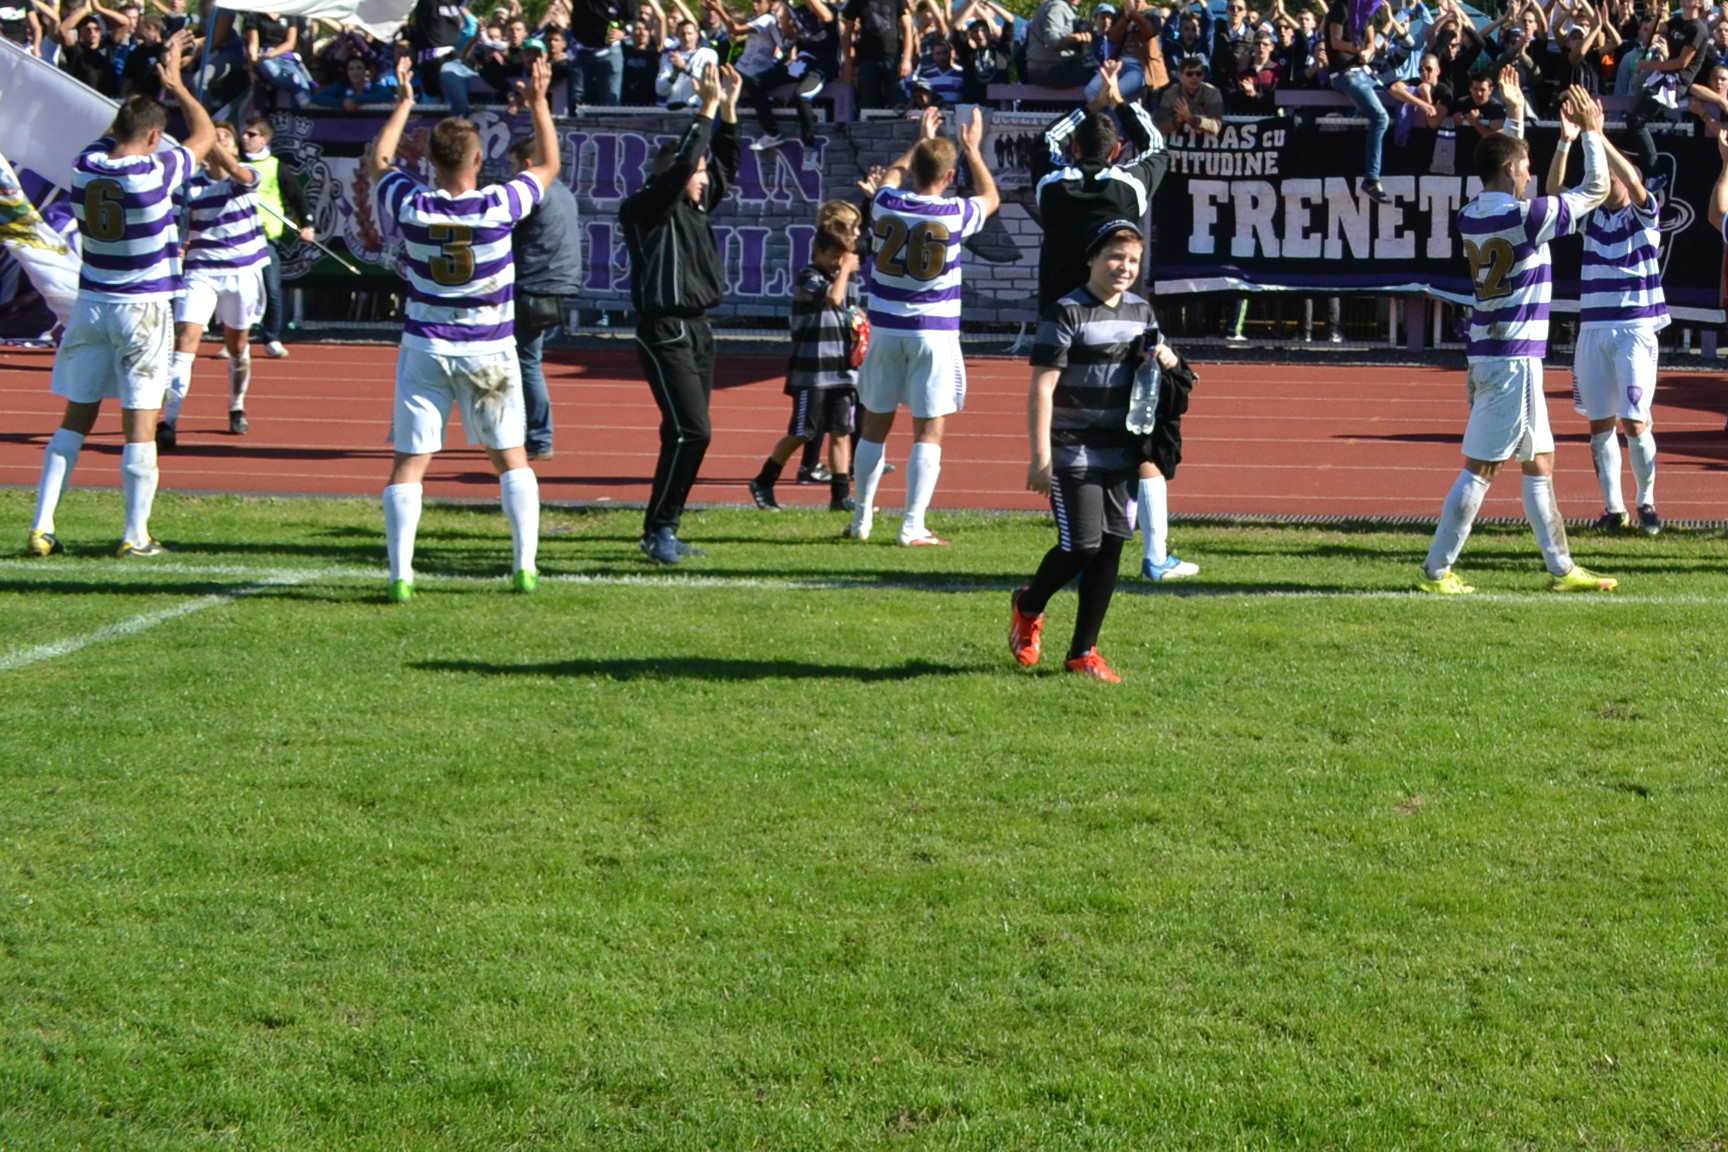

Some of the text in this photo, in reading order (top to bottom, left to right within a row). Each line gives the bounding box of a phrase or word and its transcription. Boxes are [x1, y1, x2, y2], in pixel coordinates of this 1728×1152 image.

[1167, 124, 1258, 150] LTRAS
[1167, 150, 1279, 177] TITUDINE
[84, 179, 126, 242] 6
[428, 223, 474, 286] 3
[874, 216, 950, 281] 26
